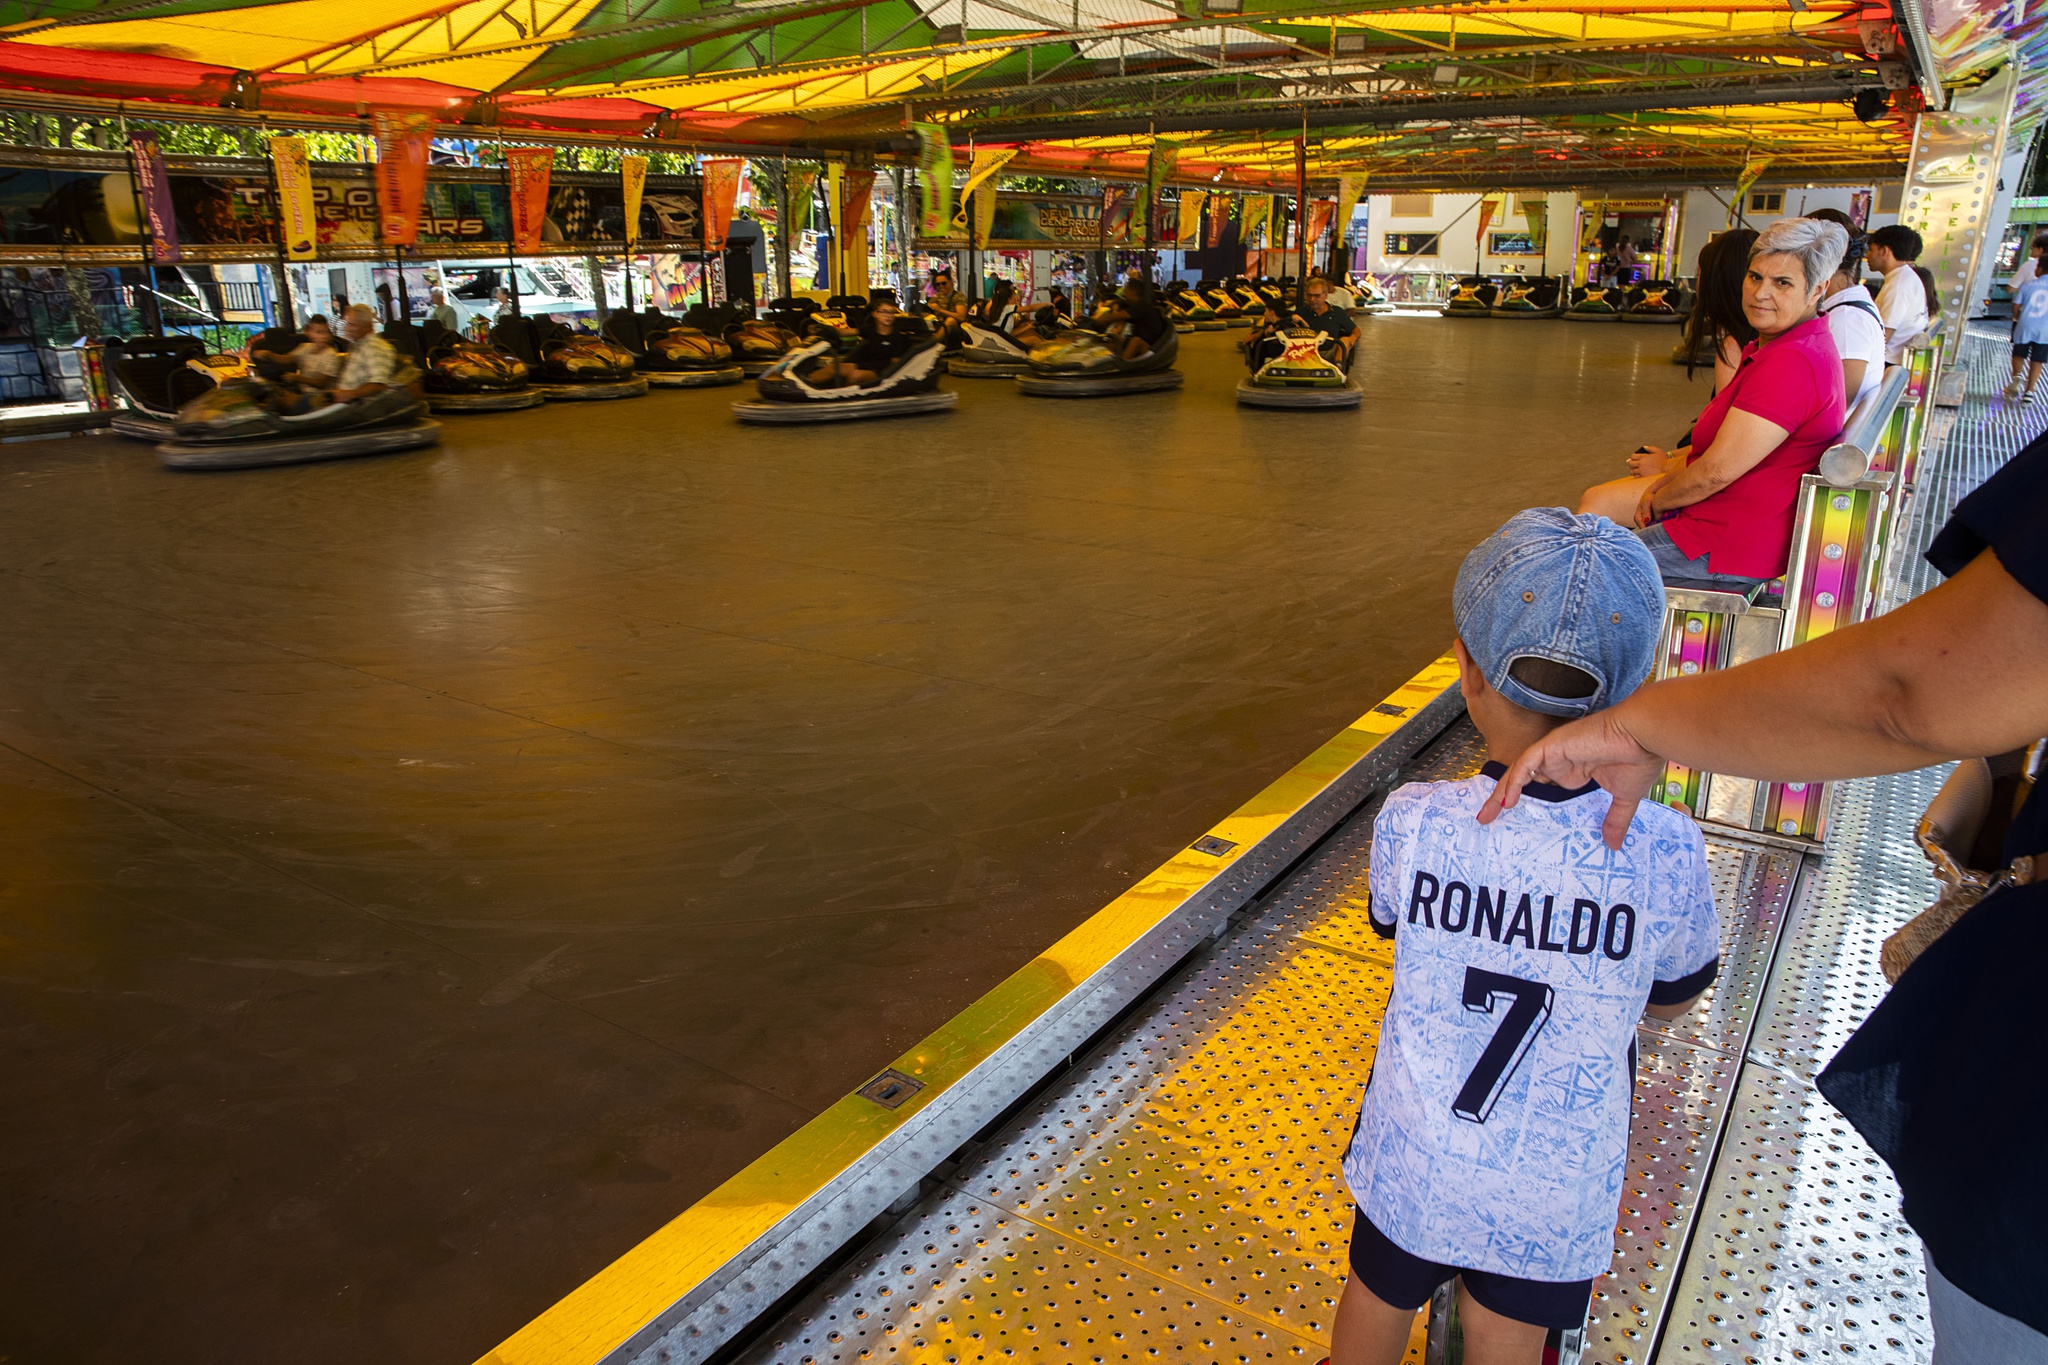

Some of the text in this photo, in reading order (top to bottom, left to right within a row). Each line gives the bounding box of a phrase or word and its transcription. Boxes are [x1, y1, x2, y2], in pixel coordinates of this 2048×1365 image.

[512, 156, 522, 192] SUPER
[235, 187, 331, 204] TP
[416, 219, 483, 235] ARS
[2028, 289, 2048, 318] 9
[1407, 870, 1636, 961] RONALDO
[1451, 966, 1555, 1125] 7
